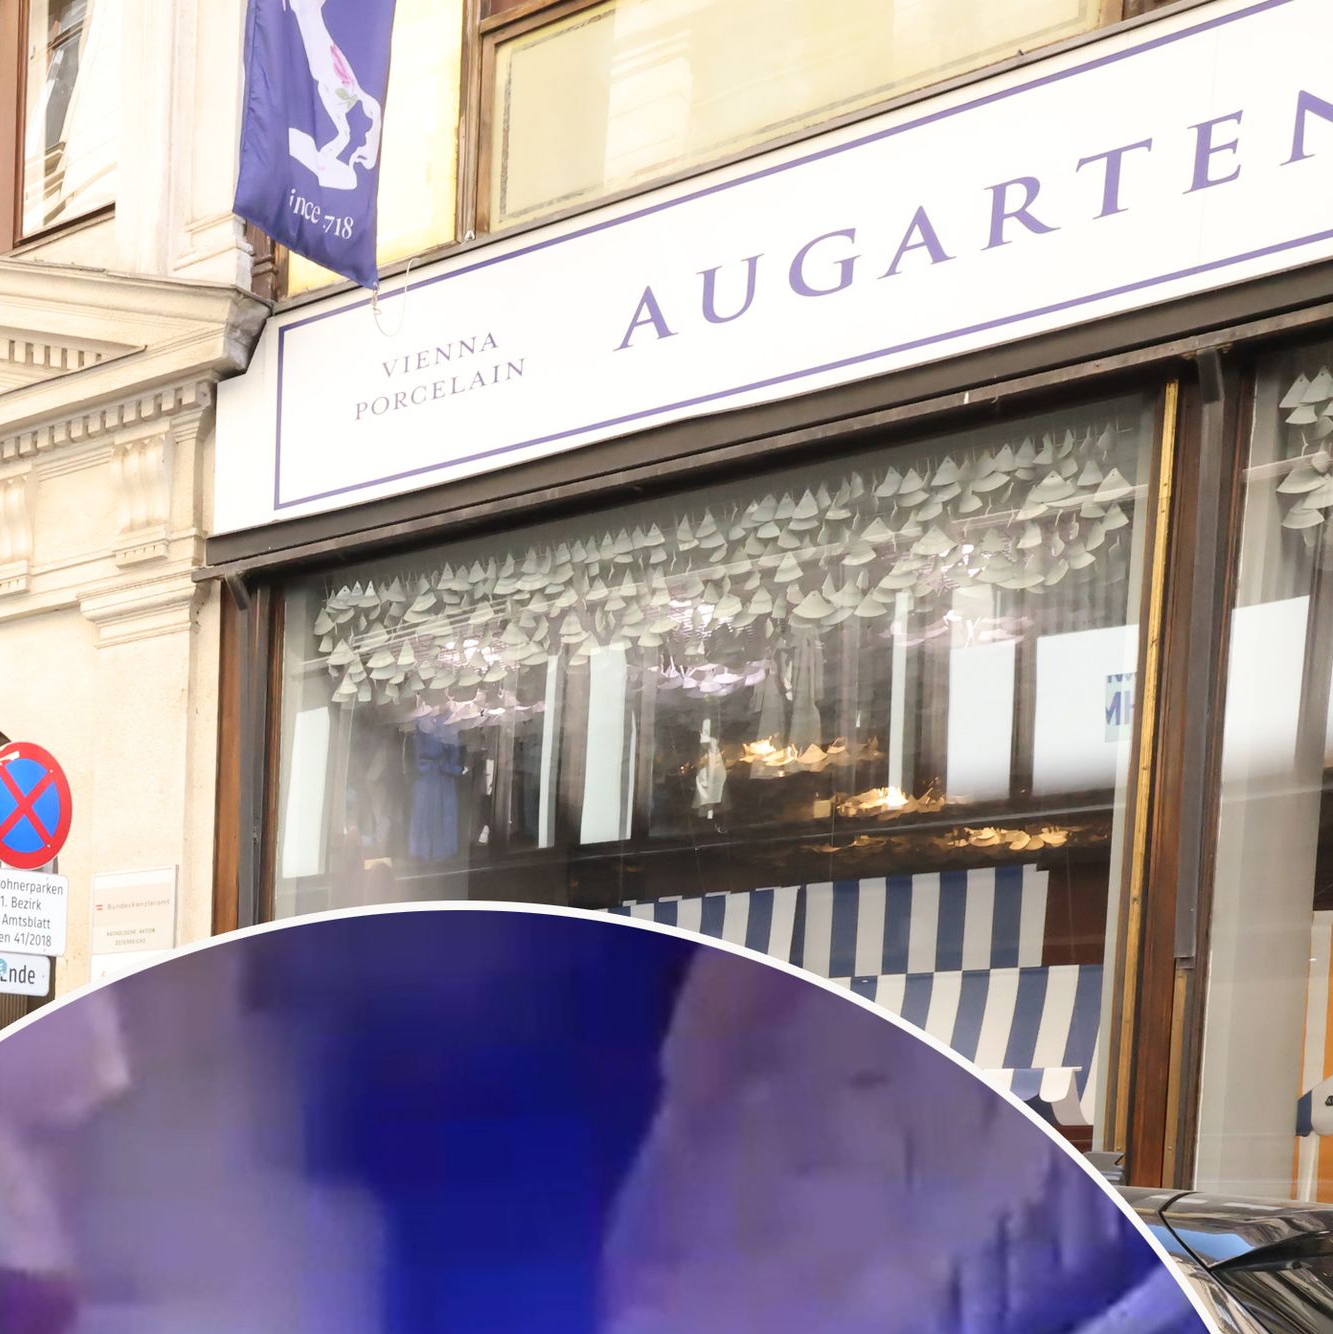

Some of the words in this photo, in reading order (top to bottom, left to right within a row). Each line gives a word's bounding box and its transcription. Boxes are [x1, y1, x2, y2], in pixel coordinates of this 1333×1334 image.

[288, 188, 321, 223] ince
[322, 216, 354, 240] 718
[612, 89, 1333, 352] AUGARTEN
[381, 331, 499, 378] VIENNA
[355, 356, 526, 421] PORCELAIN
[0, 895, 8, 907] 1.
[11, 896, 42, 911] Bezirk
[2, 913, 51, 930] Amtsblatt
[14, 932, 52, 947] 41/2018
[0, 964, 36, 985] nde
